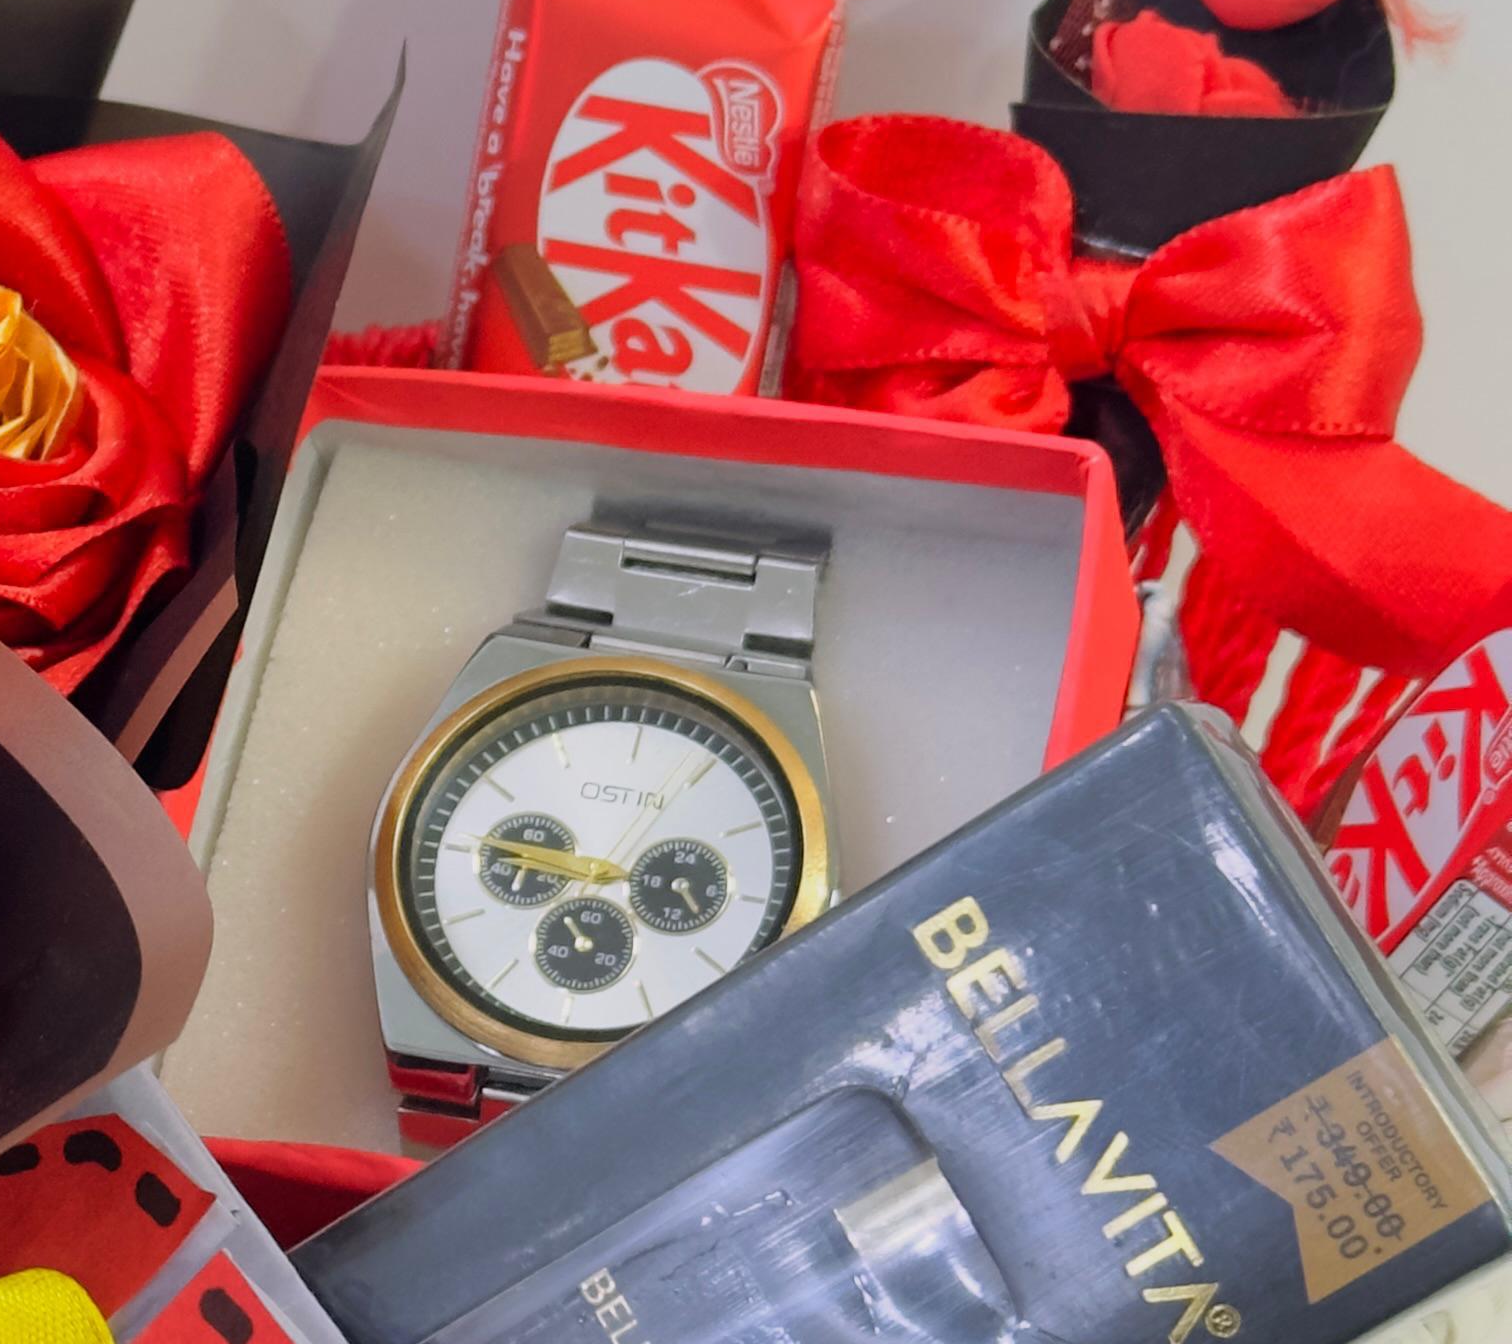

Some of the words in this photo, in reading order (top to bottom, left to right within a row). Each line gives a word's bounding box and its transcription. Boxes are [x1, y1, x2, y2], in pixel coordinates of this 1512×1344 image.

[492, 28, 526, 125] Have
[486, 131, 502, 155] a
[543, 94, 763, 388] KitKa
[1329, 645, 1509, 944] KitKa
[522, 828, 545, 843] 60
[673, 850, 696, 866] 24
[642, 873, 662, 889] 18
[579, 910, 603, 925] 60
[662, 906, 683, 921] 12
[546, 944, 569, 959] 40
[594, 952, 617, 967] 20
[1346, 1069, 1449, 1210] INTRODUCTORY
[1355, 1120, 1403, 1183] OFFER
